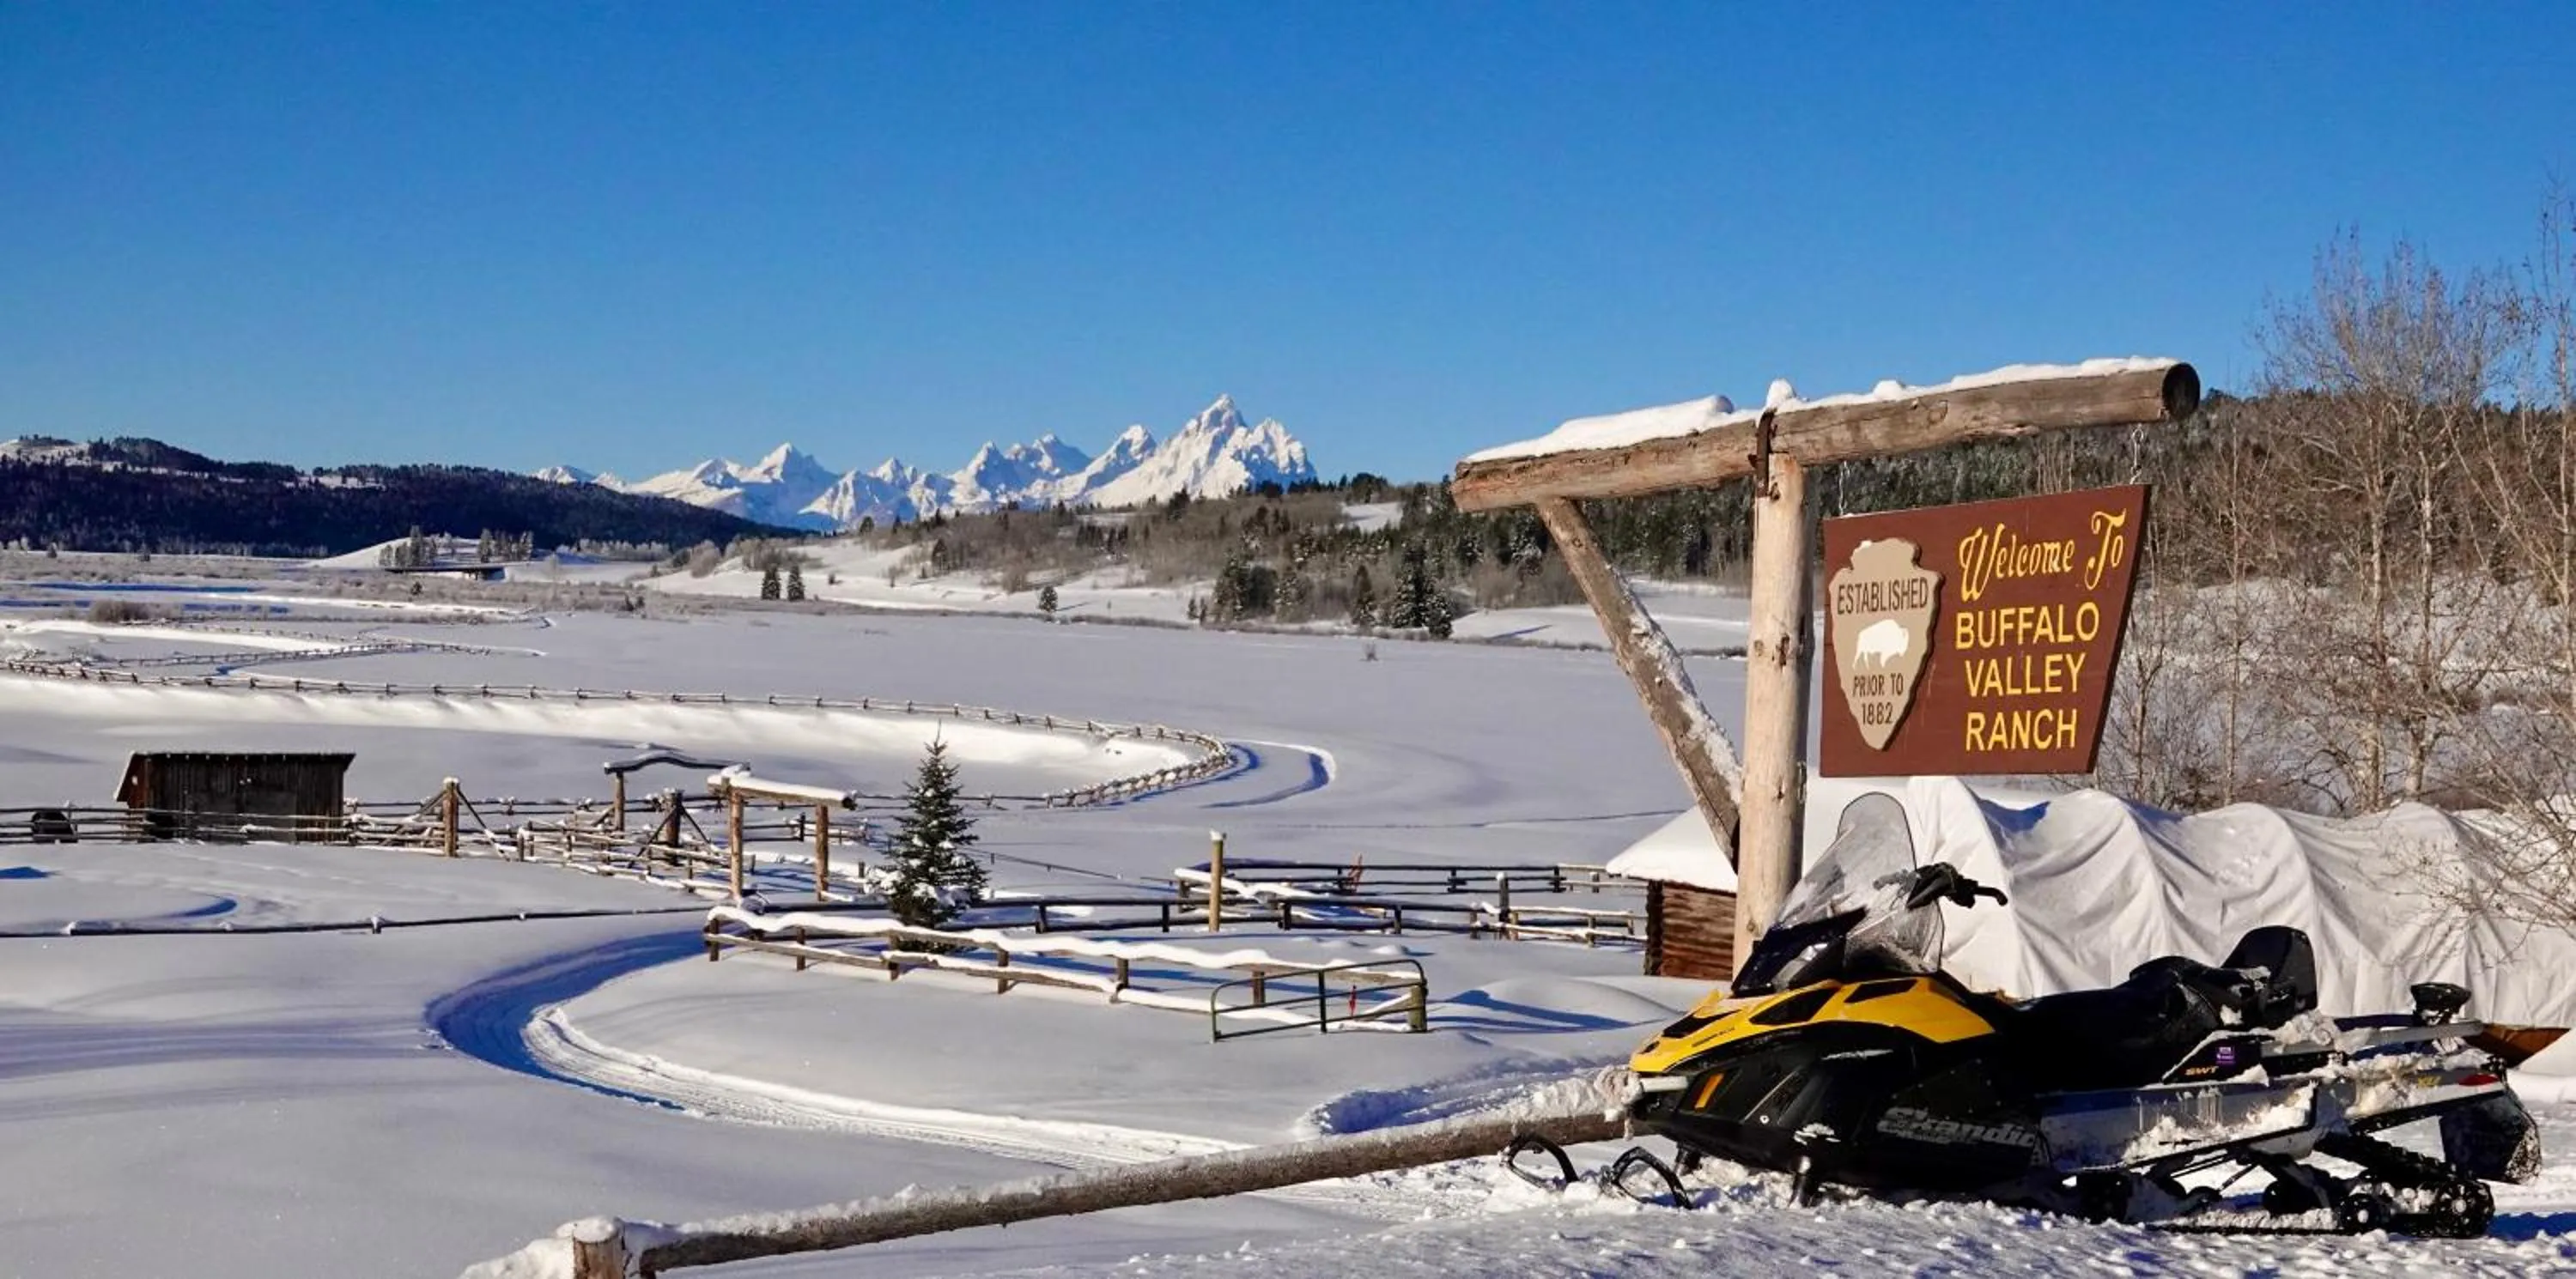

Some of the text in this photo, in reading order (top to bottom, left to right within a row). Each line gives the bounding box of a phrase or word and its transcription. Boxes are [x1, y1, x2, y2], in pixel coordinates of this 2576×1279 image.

[1959, 508, 2127, 602] Welcome To
[1837, 577, 1929, 615] ESTABLISHED
[1955, 602, 2100, 651] BUFFALO
[1852, 672, 1905, 698] PRIOR TO
[1965, 652, 2087, 698] VALLEY
[1862, 702, 1894, 725] 1882
[1965, 708, 2078, 752] RANCH
